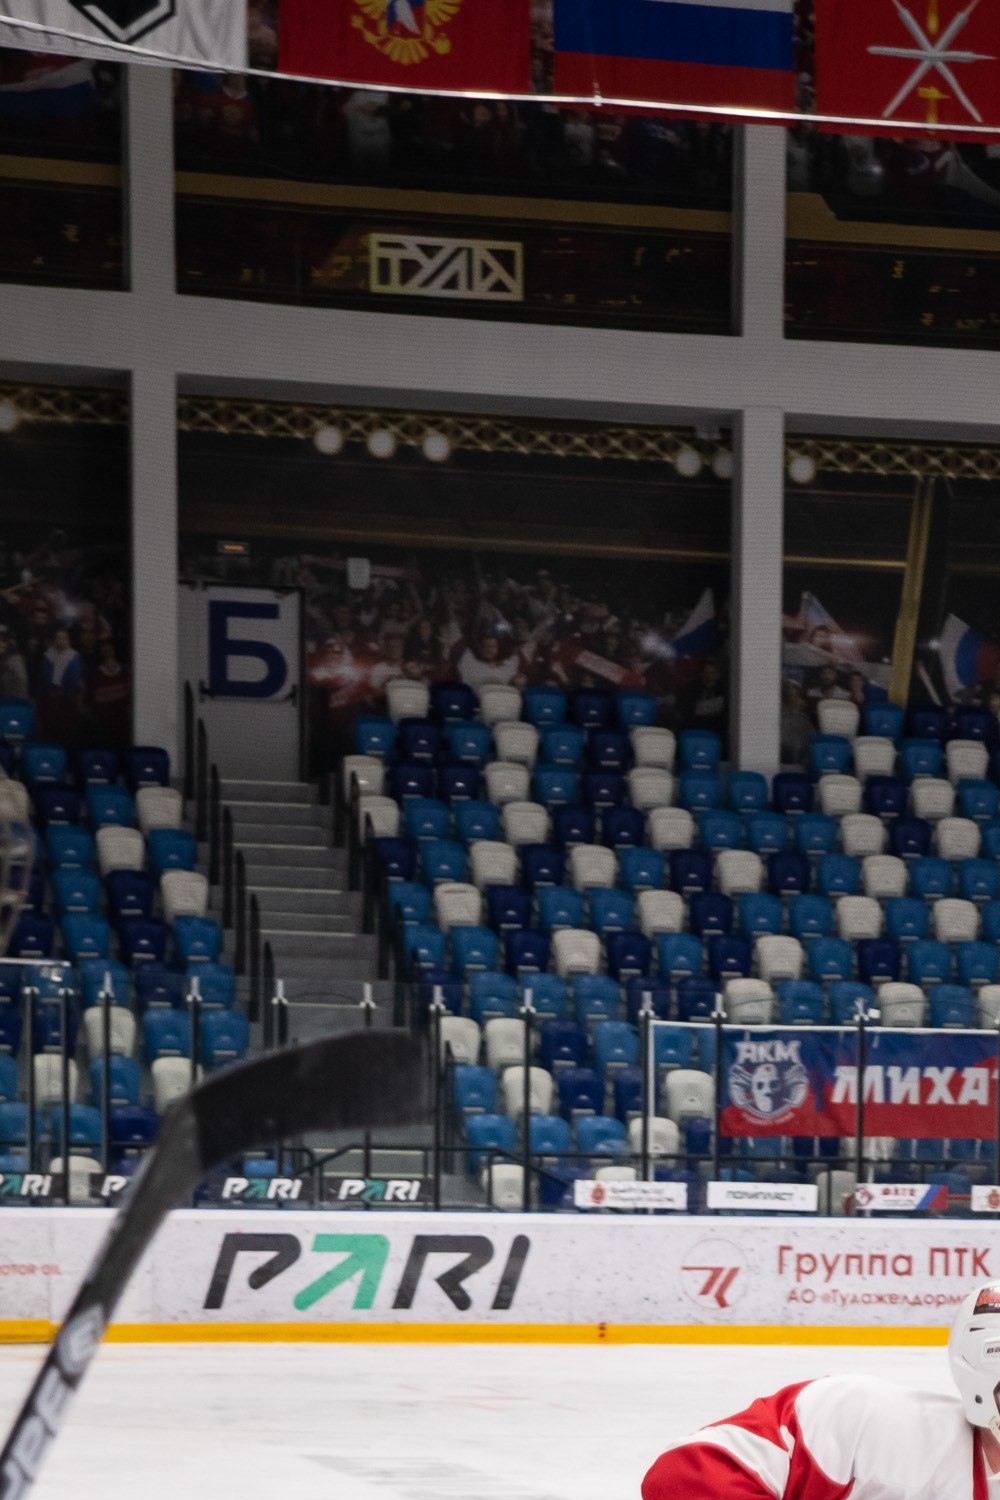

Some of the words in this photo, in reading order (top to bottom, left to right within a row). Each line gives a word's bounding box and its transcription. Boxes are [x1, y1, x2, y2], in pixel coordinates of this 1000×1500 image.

[208, 601, 288, 697] Б
[0, 1174, 52, 1197] ARI
[222, 1176, 303, 1200] PARI
[338, 1178, 421, 1202] PARI
[203, 1233, 531, 1311] PARI
[778, 1245, 913, 1282] Группа
[929, 1247, 992, 1277] ПТК
[788, 1292, 816, 1306] АО
